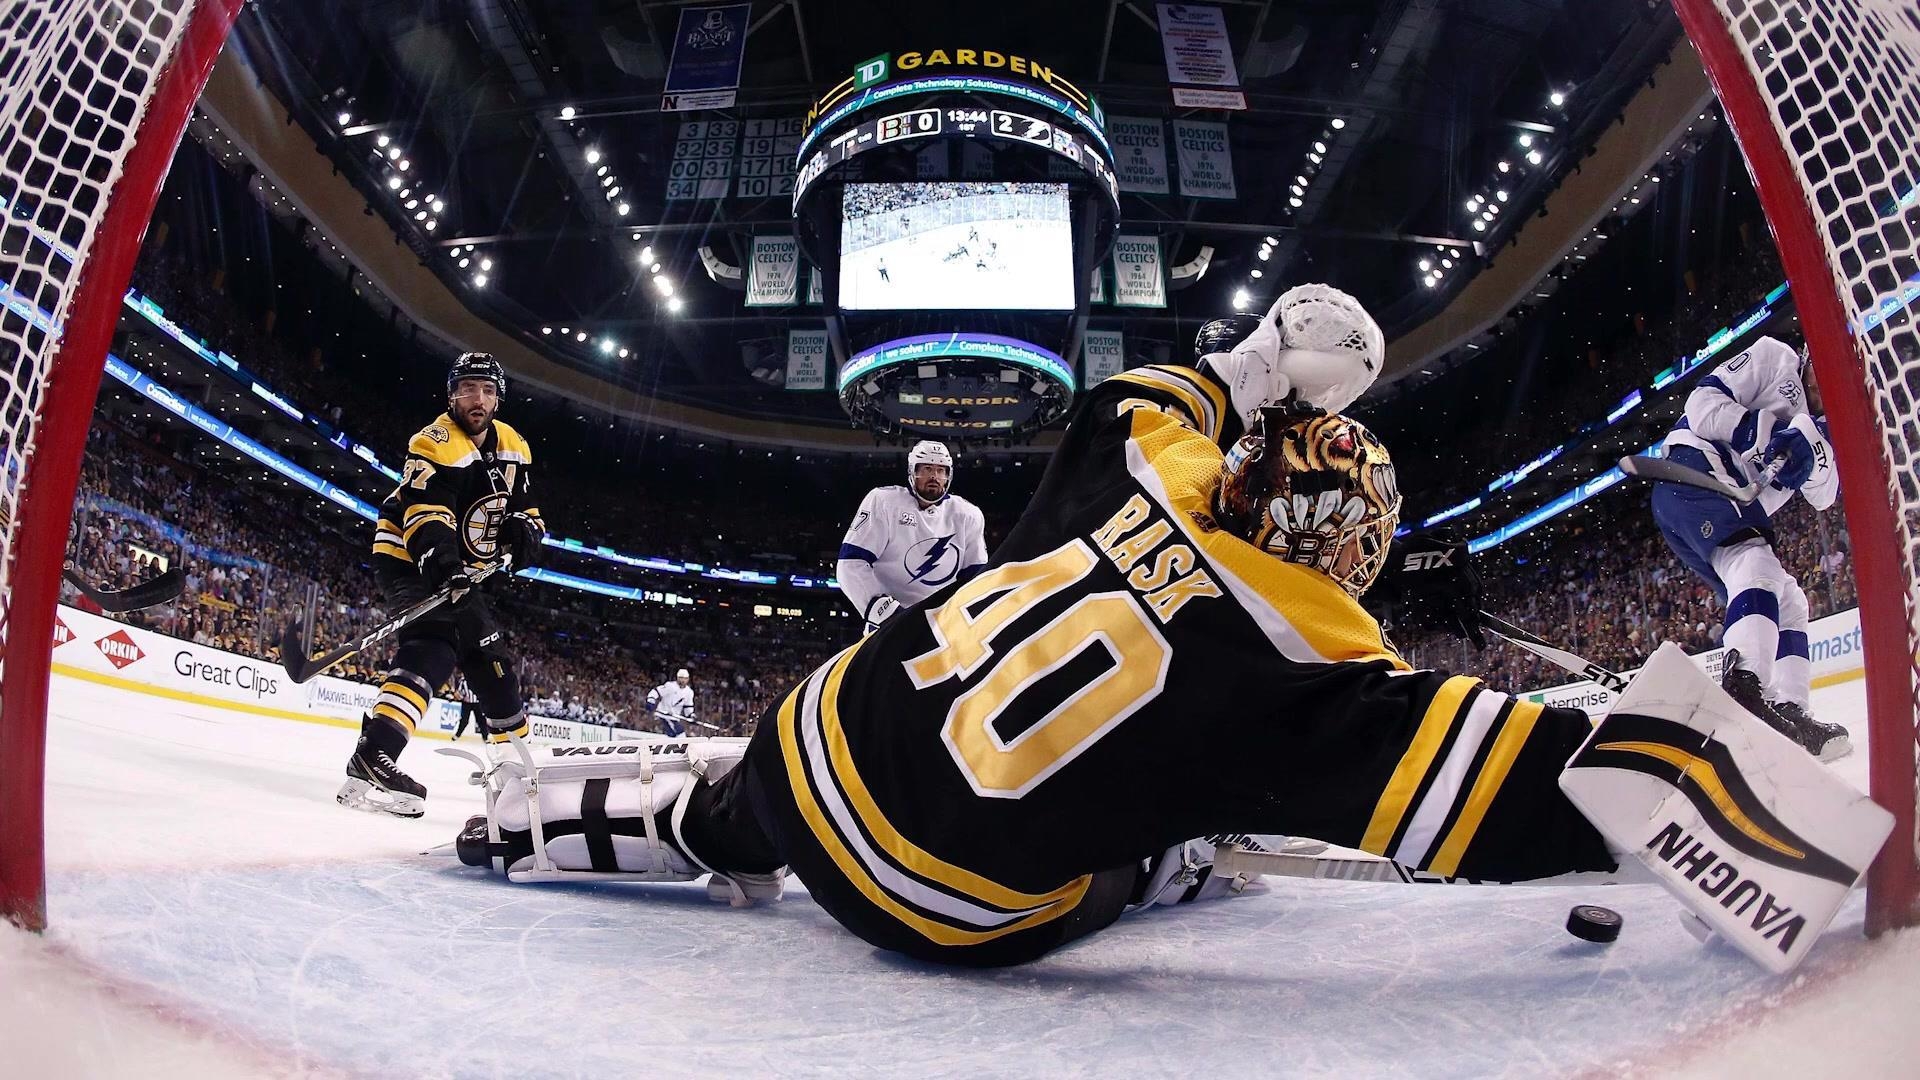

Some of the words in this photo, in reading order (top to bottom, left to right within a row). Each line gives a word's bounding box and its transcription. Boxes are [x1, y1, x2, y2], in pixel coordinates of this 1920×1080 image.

[857, 60, 885, 83] TD
[896, 49, 1052, 84] GARDEN
[873, 84, 913, 100] Complete
[915, 78, 966, 90] Technology
[966, 79, 1009, 91] Solutions
[1010, 83, 1026, 94] and
[1026, 89, 1059, 108] Services
[918, 113, 934, 131] 0
[947, 110, 988, 122] 13:44
[687, 124, 699, 137] 3
[711, 122, 737, 136] 33
[755, 122, 763, 136] 1
[998, 116, 1013, 132] 2
[1112, 123, 1159, 136] BOSTON
[1178, 127, 1224, 140] BOSTON
[706, 141, 733, 156] 35
[748, 139, 770, 154] 19
[1115, 135, 1159, 148] CELTICS
[1182, 140, 1224, 153] CELTICS
[676, 142, 701, 158] 32
[672, 162, 699, 177] 00
[705, 161, 729, 176] 31
[745, 159, 768, 174] 17
[1124, 166, 1155, 176] WORLD
[1191, 170, 1221, 180] WORLD
[668, 182, 694, 198] 34
[742, 179, 765, 195] 10
[1184, 179, 1232, 190] CHAMPIONS
[757, 243, 796, 253] BOSTON
[1117, 242, 1156, 253] BOSTON
[757, 253, 793, 263] CELTICS
[1119, 253, 1155, 263] CELTICS
[754, 288, 794, 296] CHAMPIONS
[1127, 281, 1152, 289] WORLD
[792, 336, 825, 345] BOSTON
[1087, 336, 1120, 345] BOSTON
[793, 346, 823, 354] CELTICS
[886, 349, 898, 358] we
[900, 344, 924, 355] solve
[960, 341, 1005, 353] Complete
[1006, 345, 1048, 367] Technology
[1089, 346, 1119, 355] CELTICS
[927, 396, 1019, 405] GARDEN
[1811, 440, 1829, 473] STX
[1090, 493, 1224, 625] RASK
[1402, 548, 1456, 572] STX
[360, 615, 408, 651] CCM
[100, 640, 139, 661] ORKIN
[174, 650, 232, 686] Great
[235, 665, 278, 699] Clips
[901, 538, 1173, 800] 40
[1583, 664, 1630, 695] STX
[318, 687, 352, 706] MAXWELL
[1546, 690, 1608, 709] nterprise
[442, 707, 460, 728] SAP
[533, 722, 571, 740] GATORADE
[580, 725, 602, 743] hulu
[1646, 821, 1807, 955] VAUGHN
